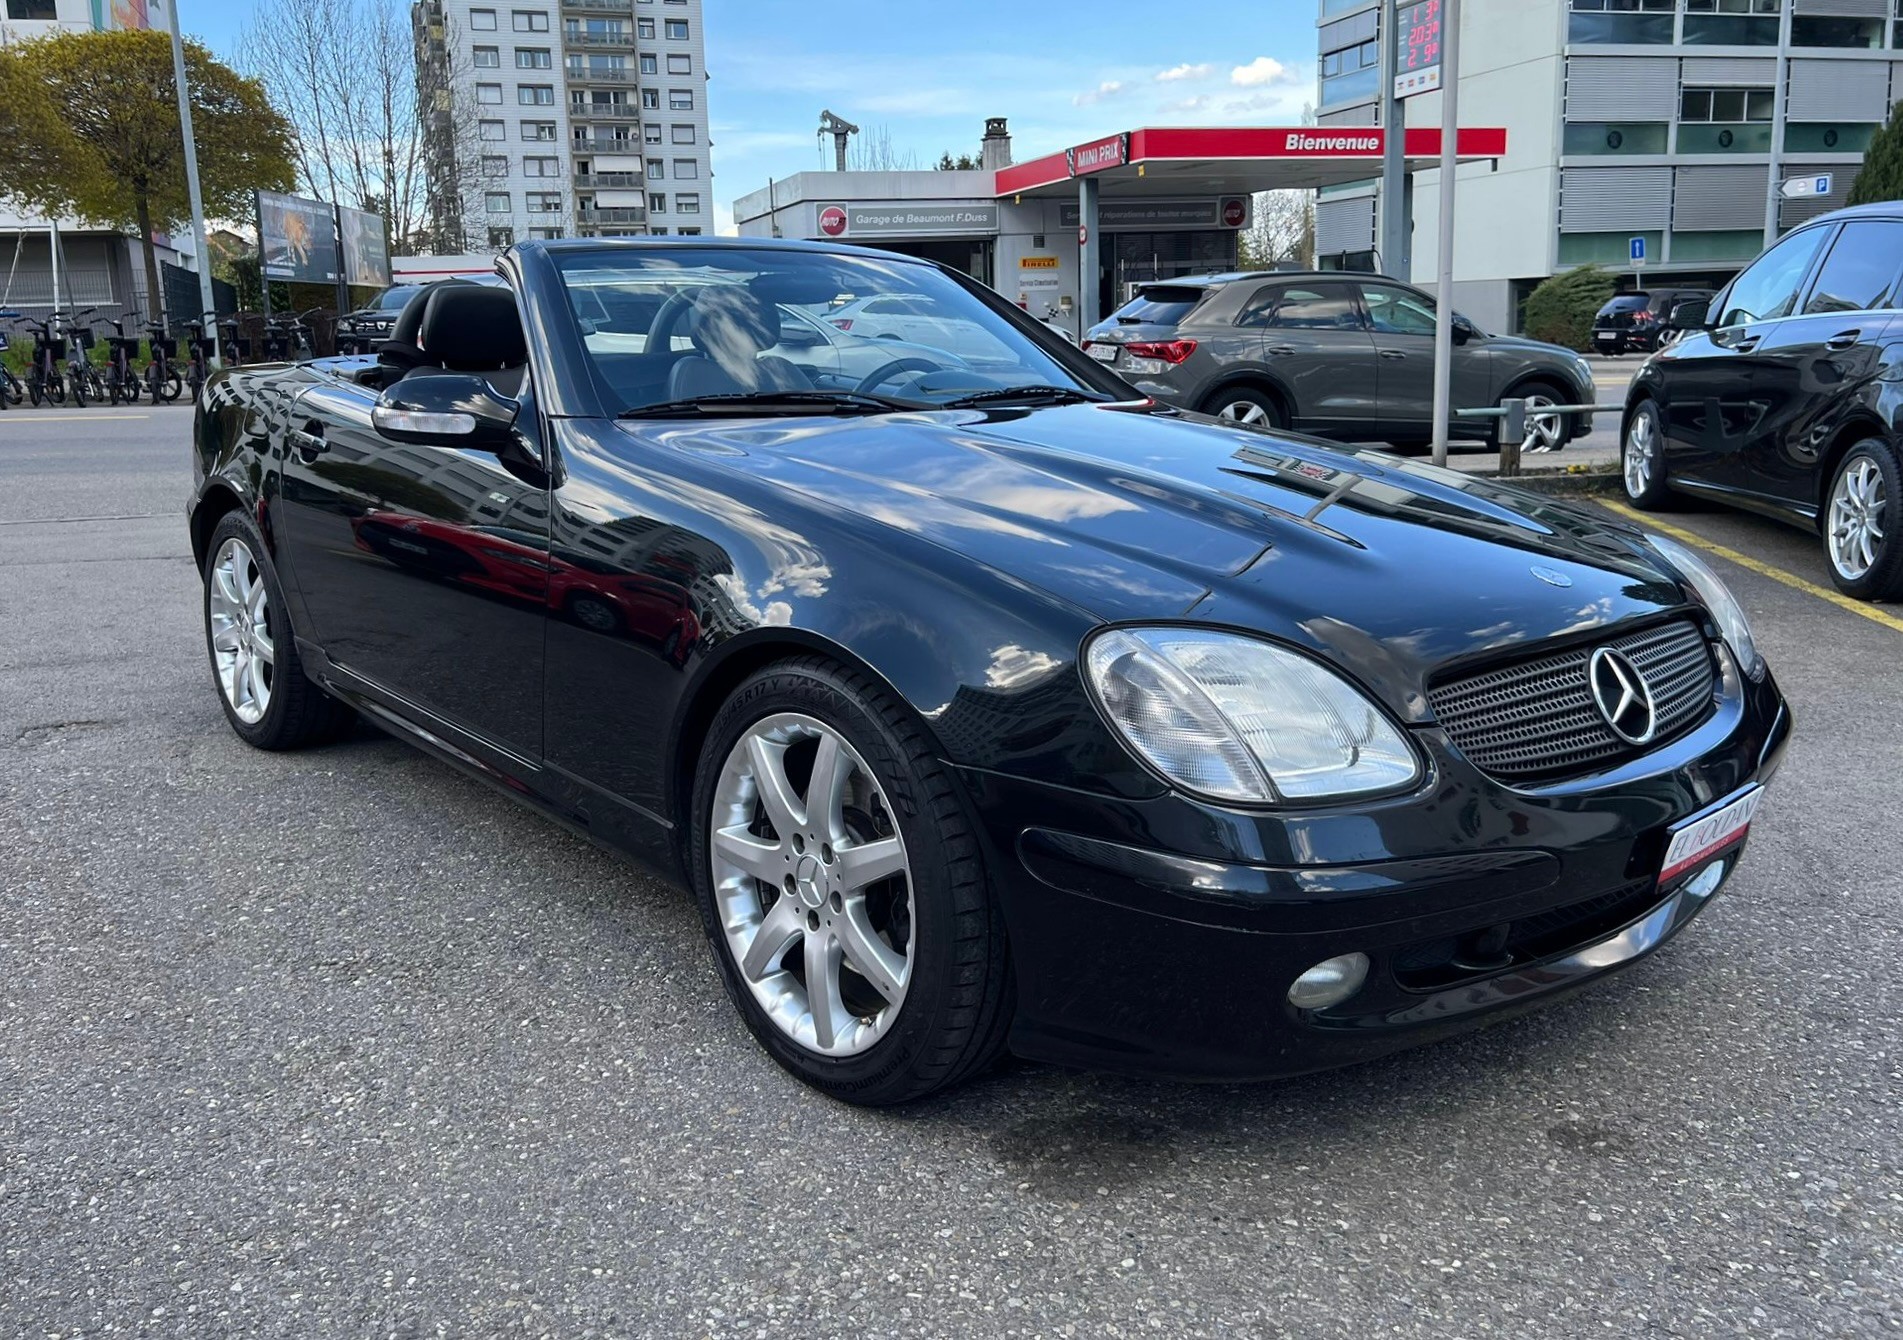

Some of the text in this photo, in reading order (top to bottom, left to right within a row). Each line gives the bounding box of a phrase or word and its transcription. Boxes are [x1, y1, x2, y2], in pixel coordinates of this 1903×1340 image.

[1284, 133, 1379, 151] Bienvenue
[1077, 141, 1119, 168] MINI PRIX
[855, 212, 988, 226] Garage de Beaumont F.Duss
[1022, 258, 1056, 268] PIRELLI
